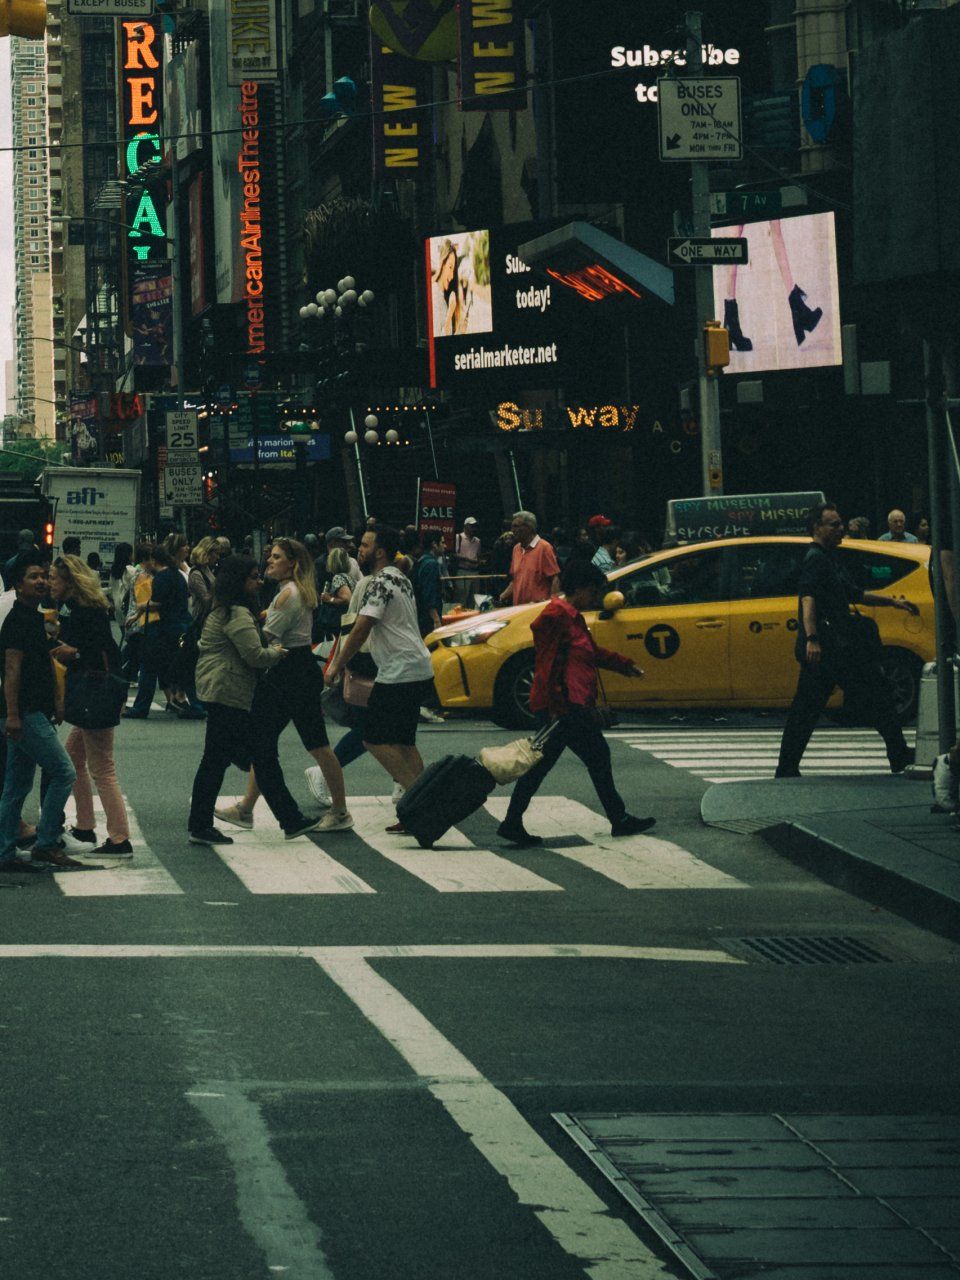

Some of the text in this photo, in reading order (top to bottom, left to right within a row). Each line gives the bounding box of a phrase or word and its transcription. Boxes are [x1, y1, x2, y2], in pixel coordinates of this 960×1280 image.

[677, 84, 723, 99] BUSES
[681, 103, 717, 116] ONLY
[382, 83, 419, 168] NEW
[680, 245, 737, 257] ONE WAY
[516, 284, 552, 313] today!
[454, 341, 558, 371] serialmarketer.net
[170, 432, 195, 448] 25
[257, 449, 279, 459] from
[169, 467, 198, 476] BUSES
[172, 477, 195, 486] ONLY
[66, 487, 105, 506] afr
[422, 506, 454, 519] SALE
[651, 629, 671, 655] T
